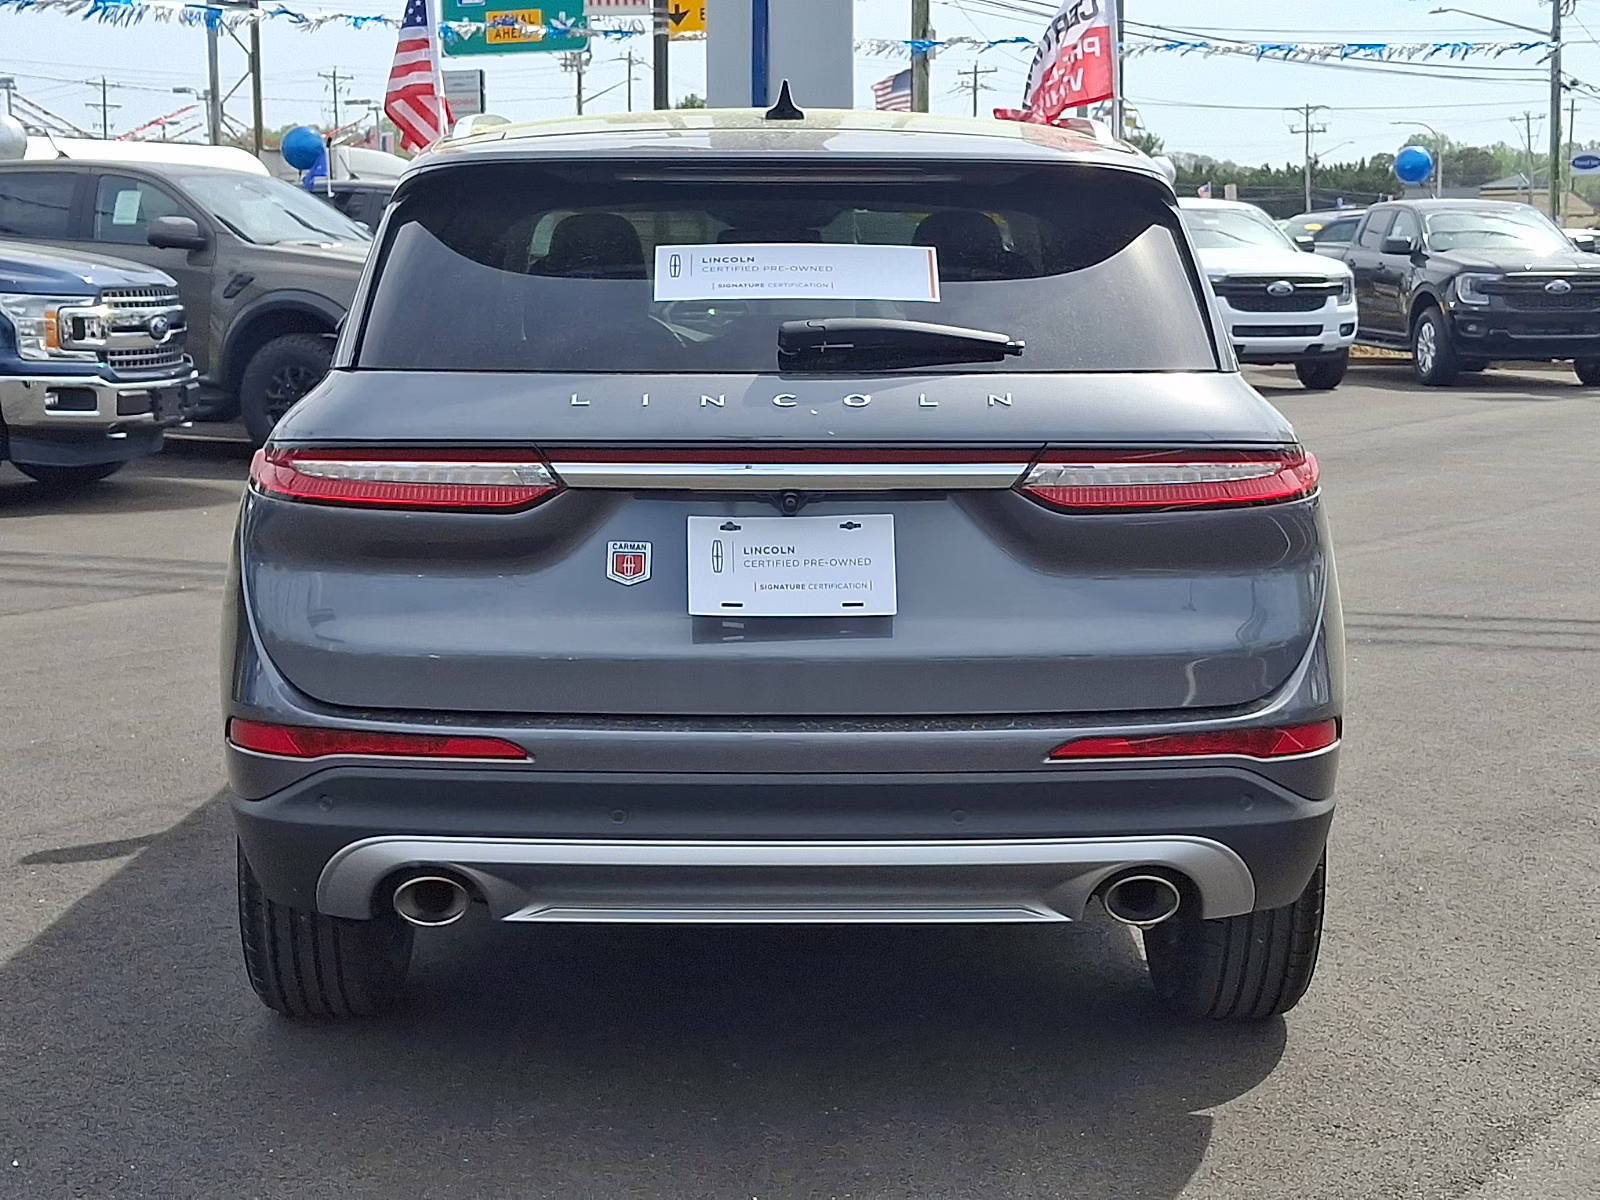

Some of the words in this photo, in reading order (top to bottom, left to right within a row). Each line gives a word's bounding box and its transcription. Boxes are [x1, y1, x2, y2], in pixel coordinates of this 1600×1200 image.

[701, 265, 759, 273] CERTIFIED
[571, 393, 1013, 407] LINCOLN
[743, 546, 795, 555] LINCOLN
[743, 559, 800, 568] CERTIFIED
[803, 558, 872, 567] PRE-OWNED
[808, 582, 868, 590] CERTIFICATION
